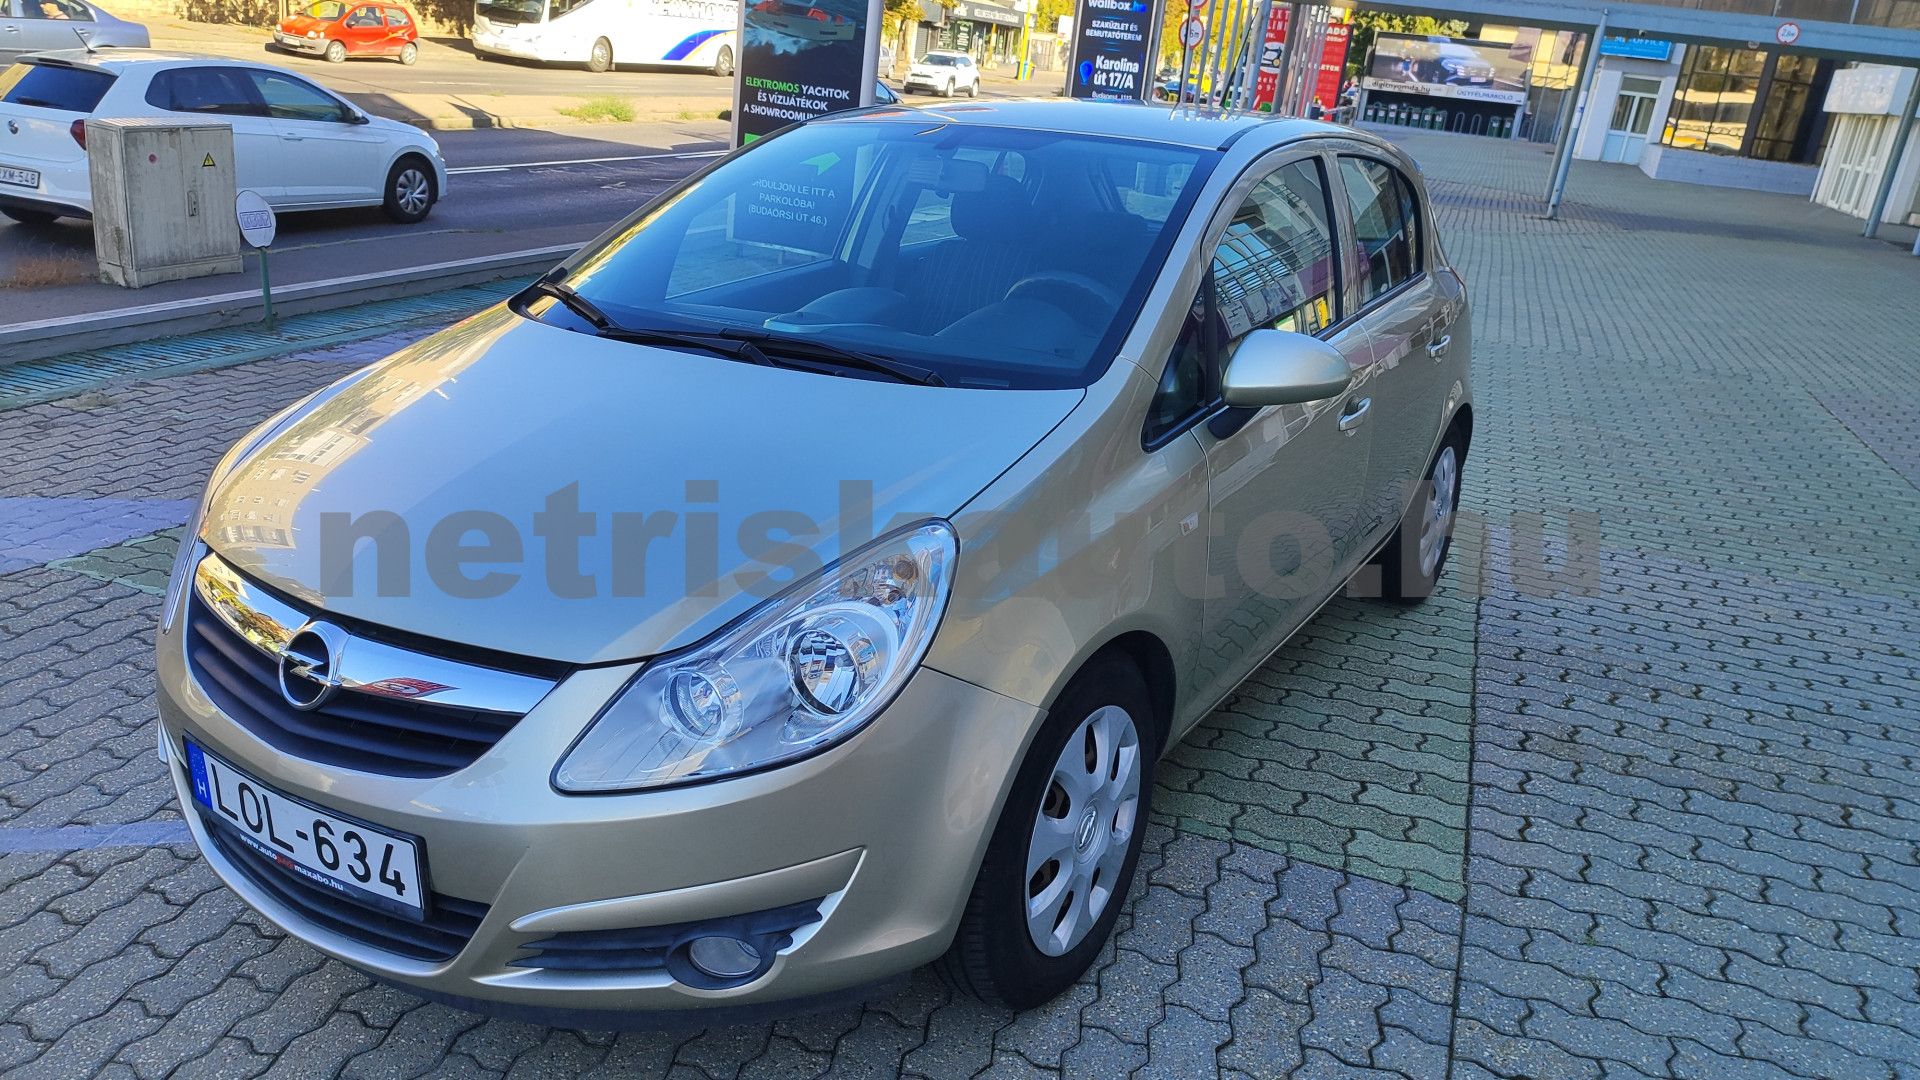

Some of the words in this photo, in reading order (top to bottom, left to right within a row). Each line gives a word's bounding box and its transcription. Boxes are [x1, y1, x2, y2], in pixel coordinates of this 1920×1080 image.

[1085, 28, 1142, 42] BEMUTATÓTEREM
[1091, 20, 1129, 31] SZAKÜZLET
[1129, 22, 1139, 32] ÉS
[1095, 55, 1139, 73] Karolina
[745, 76, 800, 94] ELEKTROMOS
[801, 84, 850, 101] YACHTOK
[1093, 70, 1107, 86] út
[1108, 72, 1134, 90] 17/A
[757, 90, 767, 102] ÉS
[743, 103, 750, 113] A
[0, 168, 36, 185] XM-548
[751, 179, 796, 193] RDULJON
[797, 185, 809, 195] LE
[811, 187, 827, 197] ITT
[827, 189, 836, 199] A
[197, 778, 208, 799] H
[210, 762, 406, 897] LOL-634
